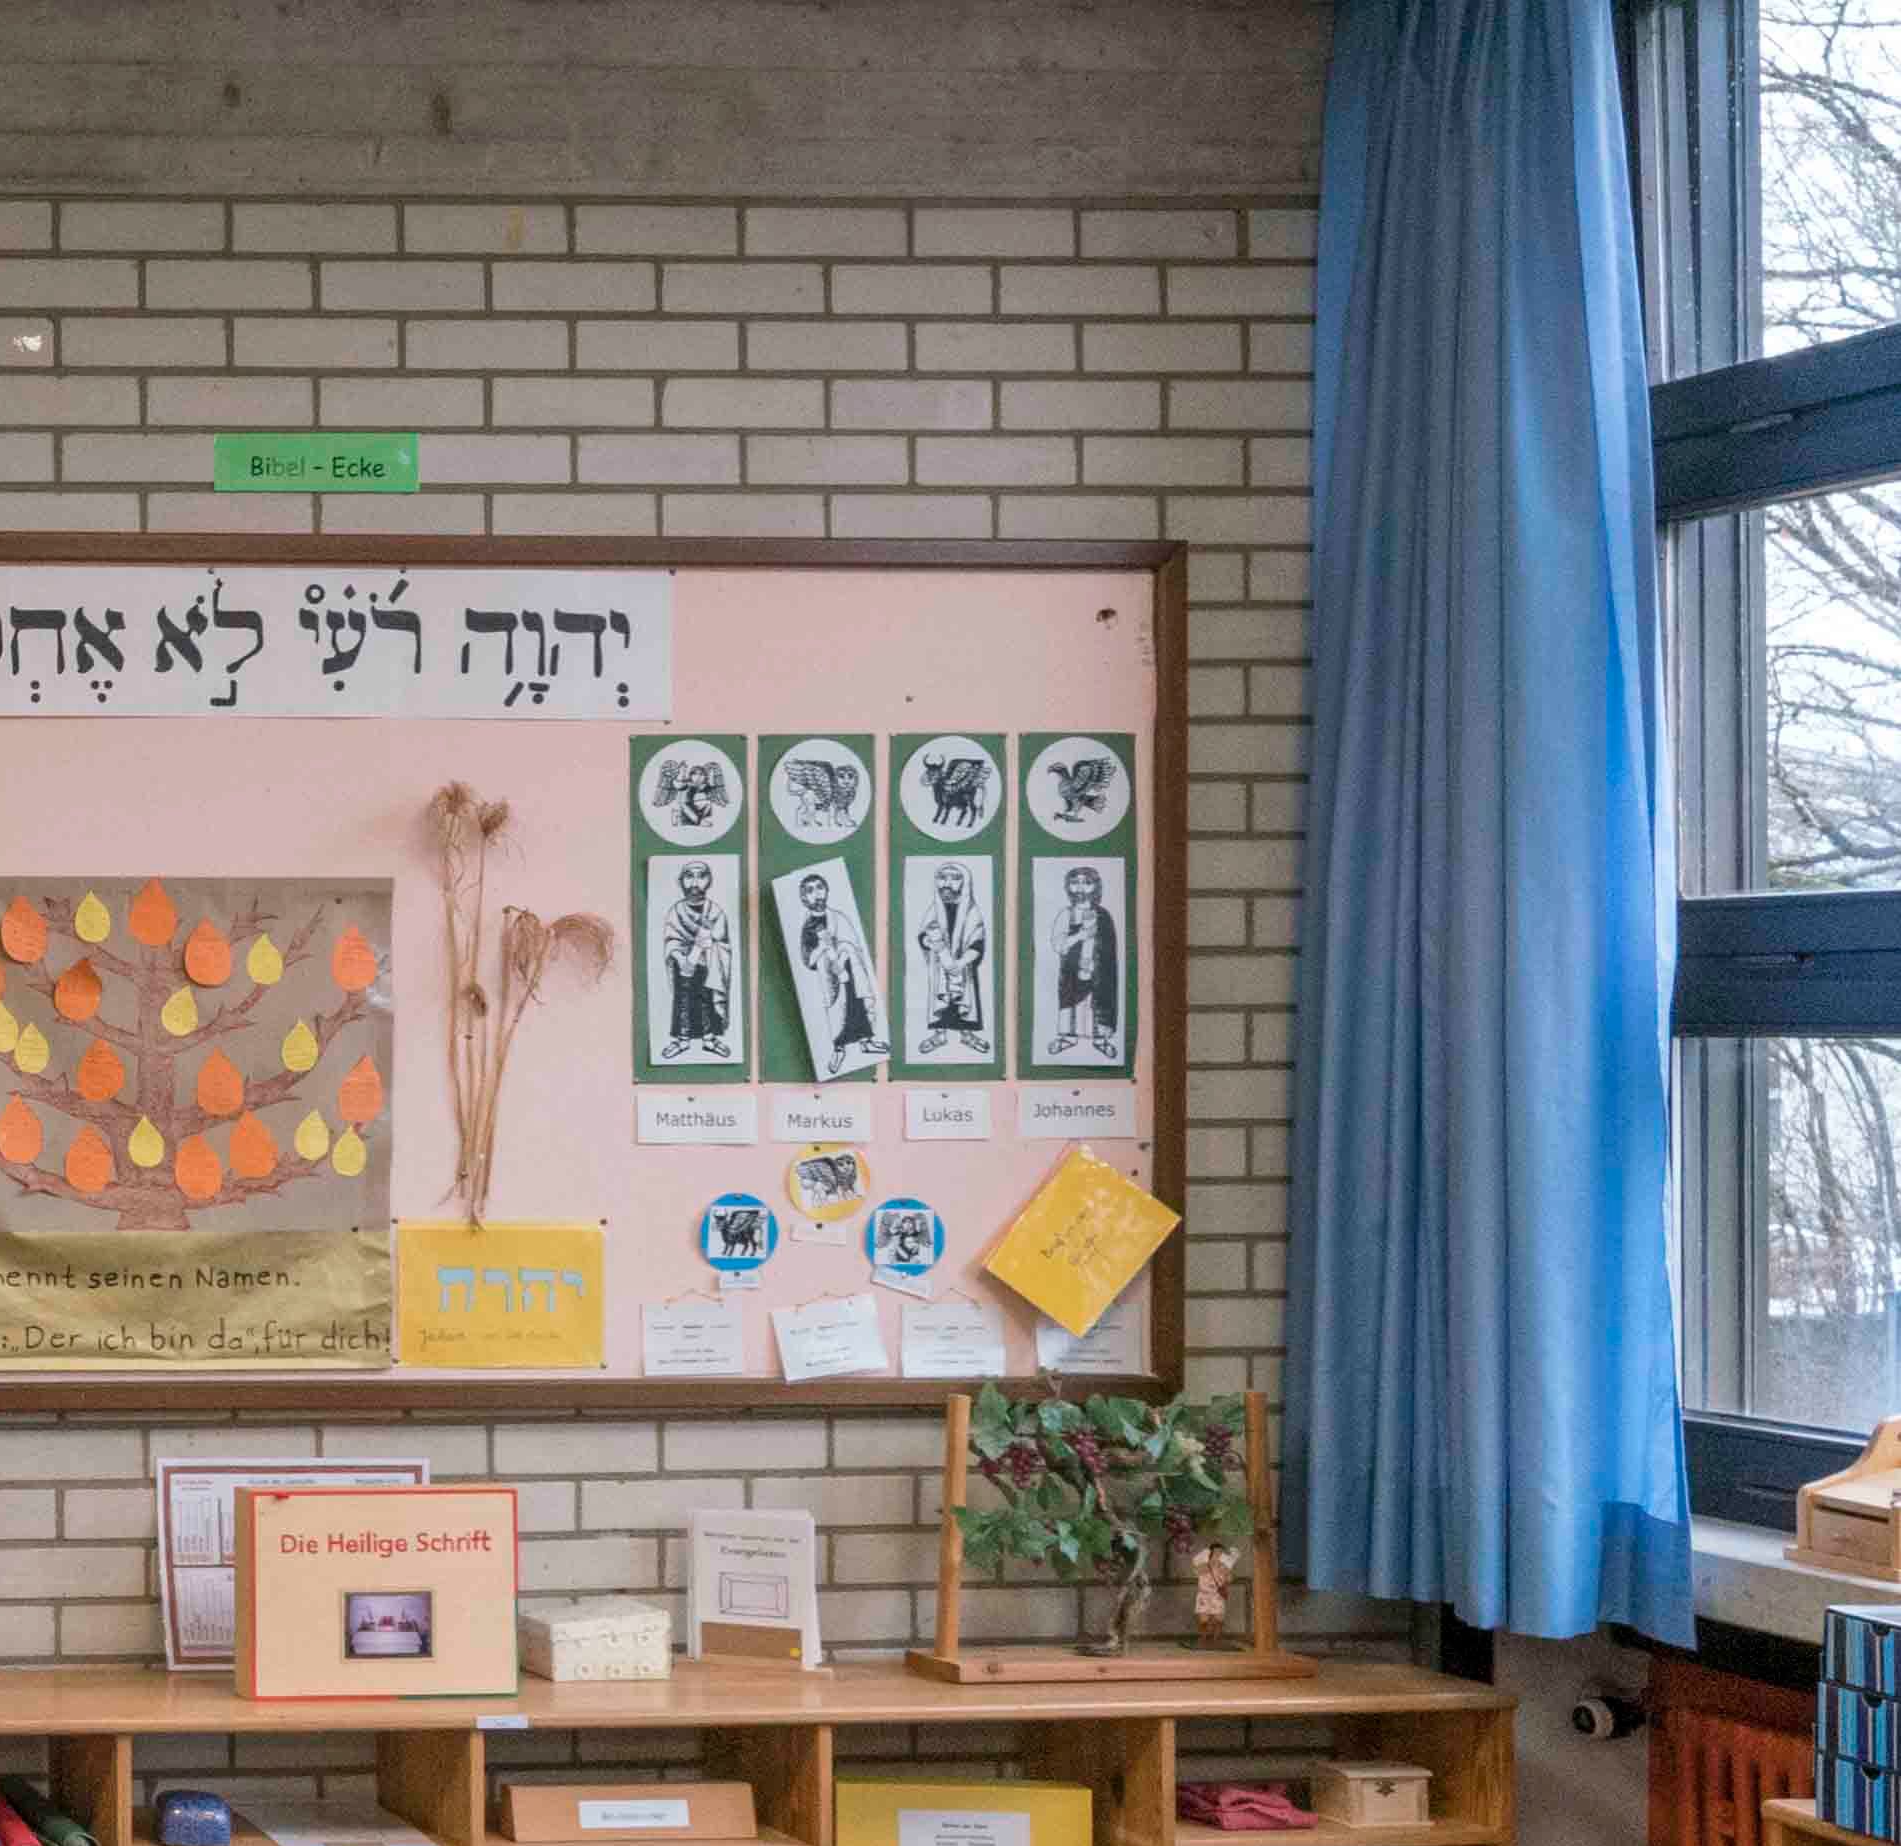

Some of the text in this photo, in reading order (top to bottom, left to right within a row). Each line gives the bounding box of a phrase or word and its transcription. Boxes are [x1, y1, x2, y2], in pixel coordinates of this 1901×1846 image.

[250, 456, 305, 477] Bibel
[332, 456, 385, 478] Ecke
[655, 1111, 736, 1128] Matthäus
[922, 1106, 974, 1122] Lukas
[1033, 1101, 1116, 1119] Johannes
[786, 1113, 854, 1128] Markus
[87, 1265, 183, 1288] seinen
[195, 1266, 301, 1288] Namen.
[97, 1324, 137, 1351] ich
[150, 1320, 195, 1351] bin
[320, 1319, 391, 1352] dich!
[279, 1529, 493, 1559] Die Heilige Schrift
